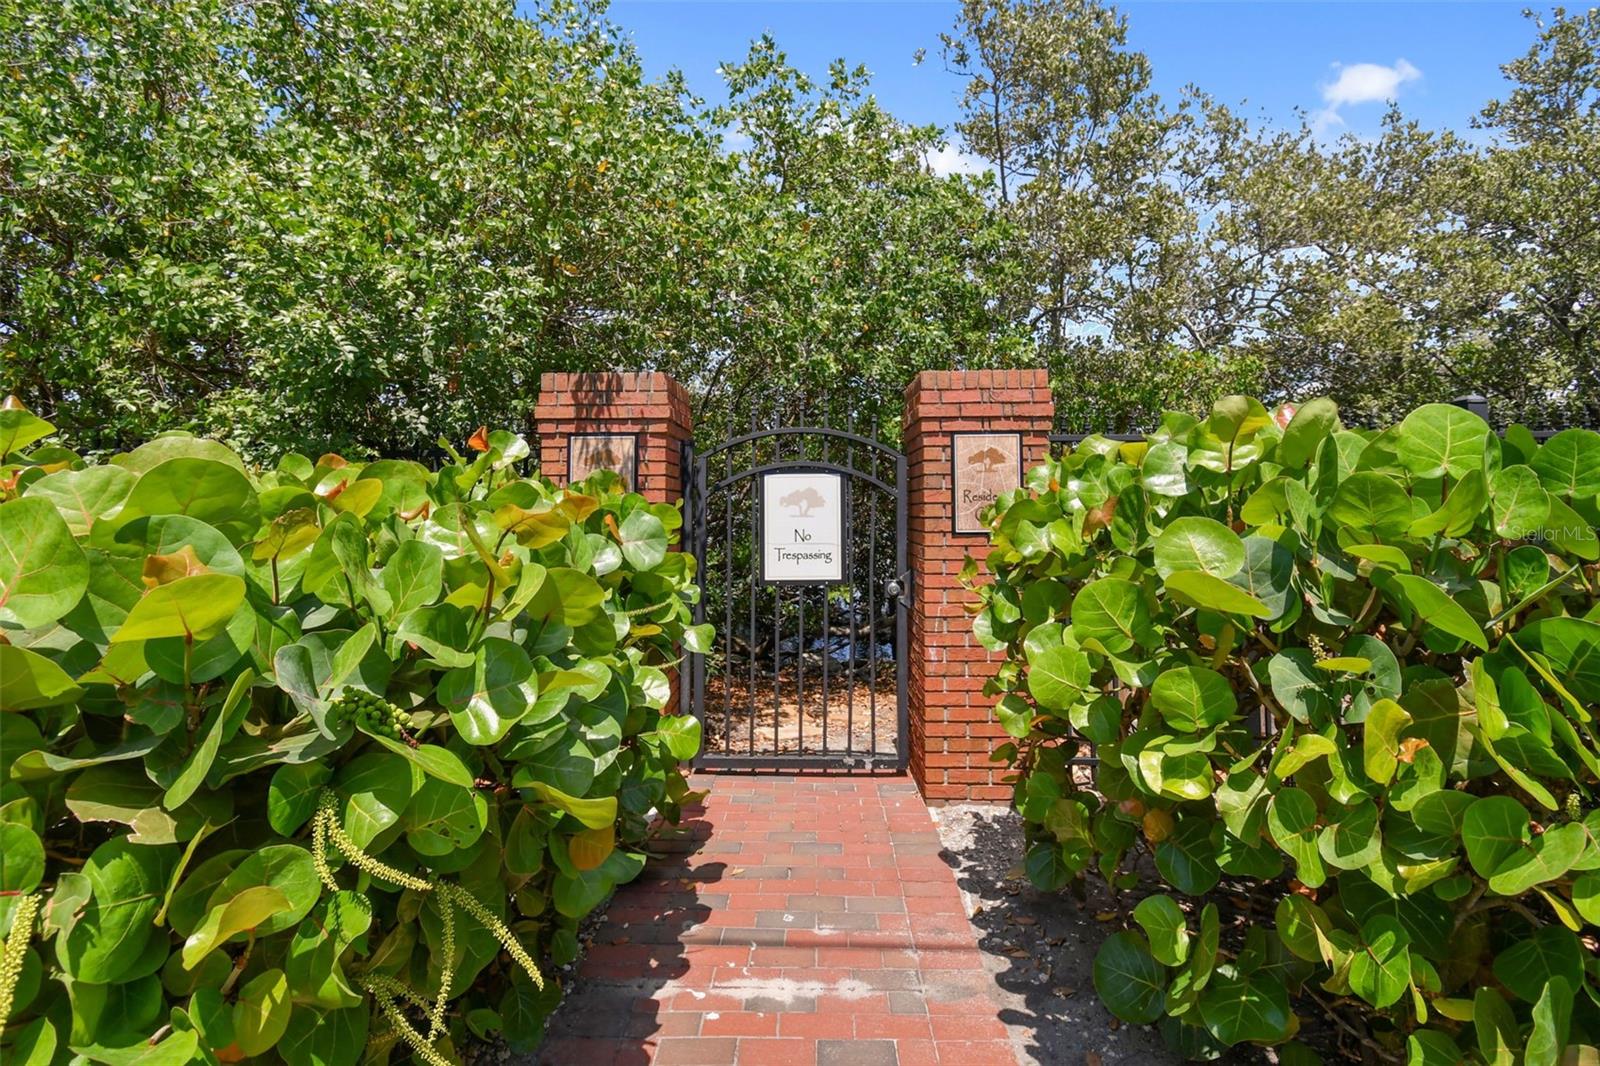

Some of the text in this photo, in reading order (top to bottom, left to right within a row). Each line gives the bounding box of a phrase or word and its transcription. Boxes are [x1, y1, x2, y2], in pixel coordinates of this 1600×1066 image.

[963, 488, 998, 503] Reside
[795, 529, 812, 543] No
[774, 547, 833, 565] Trespassing
